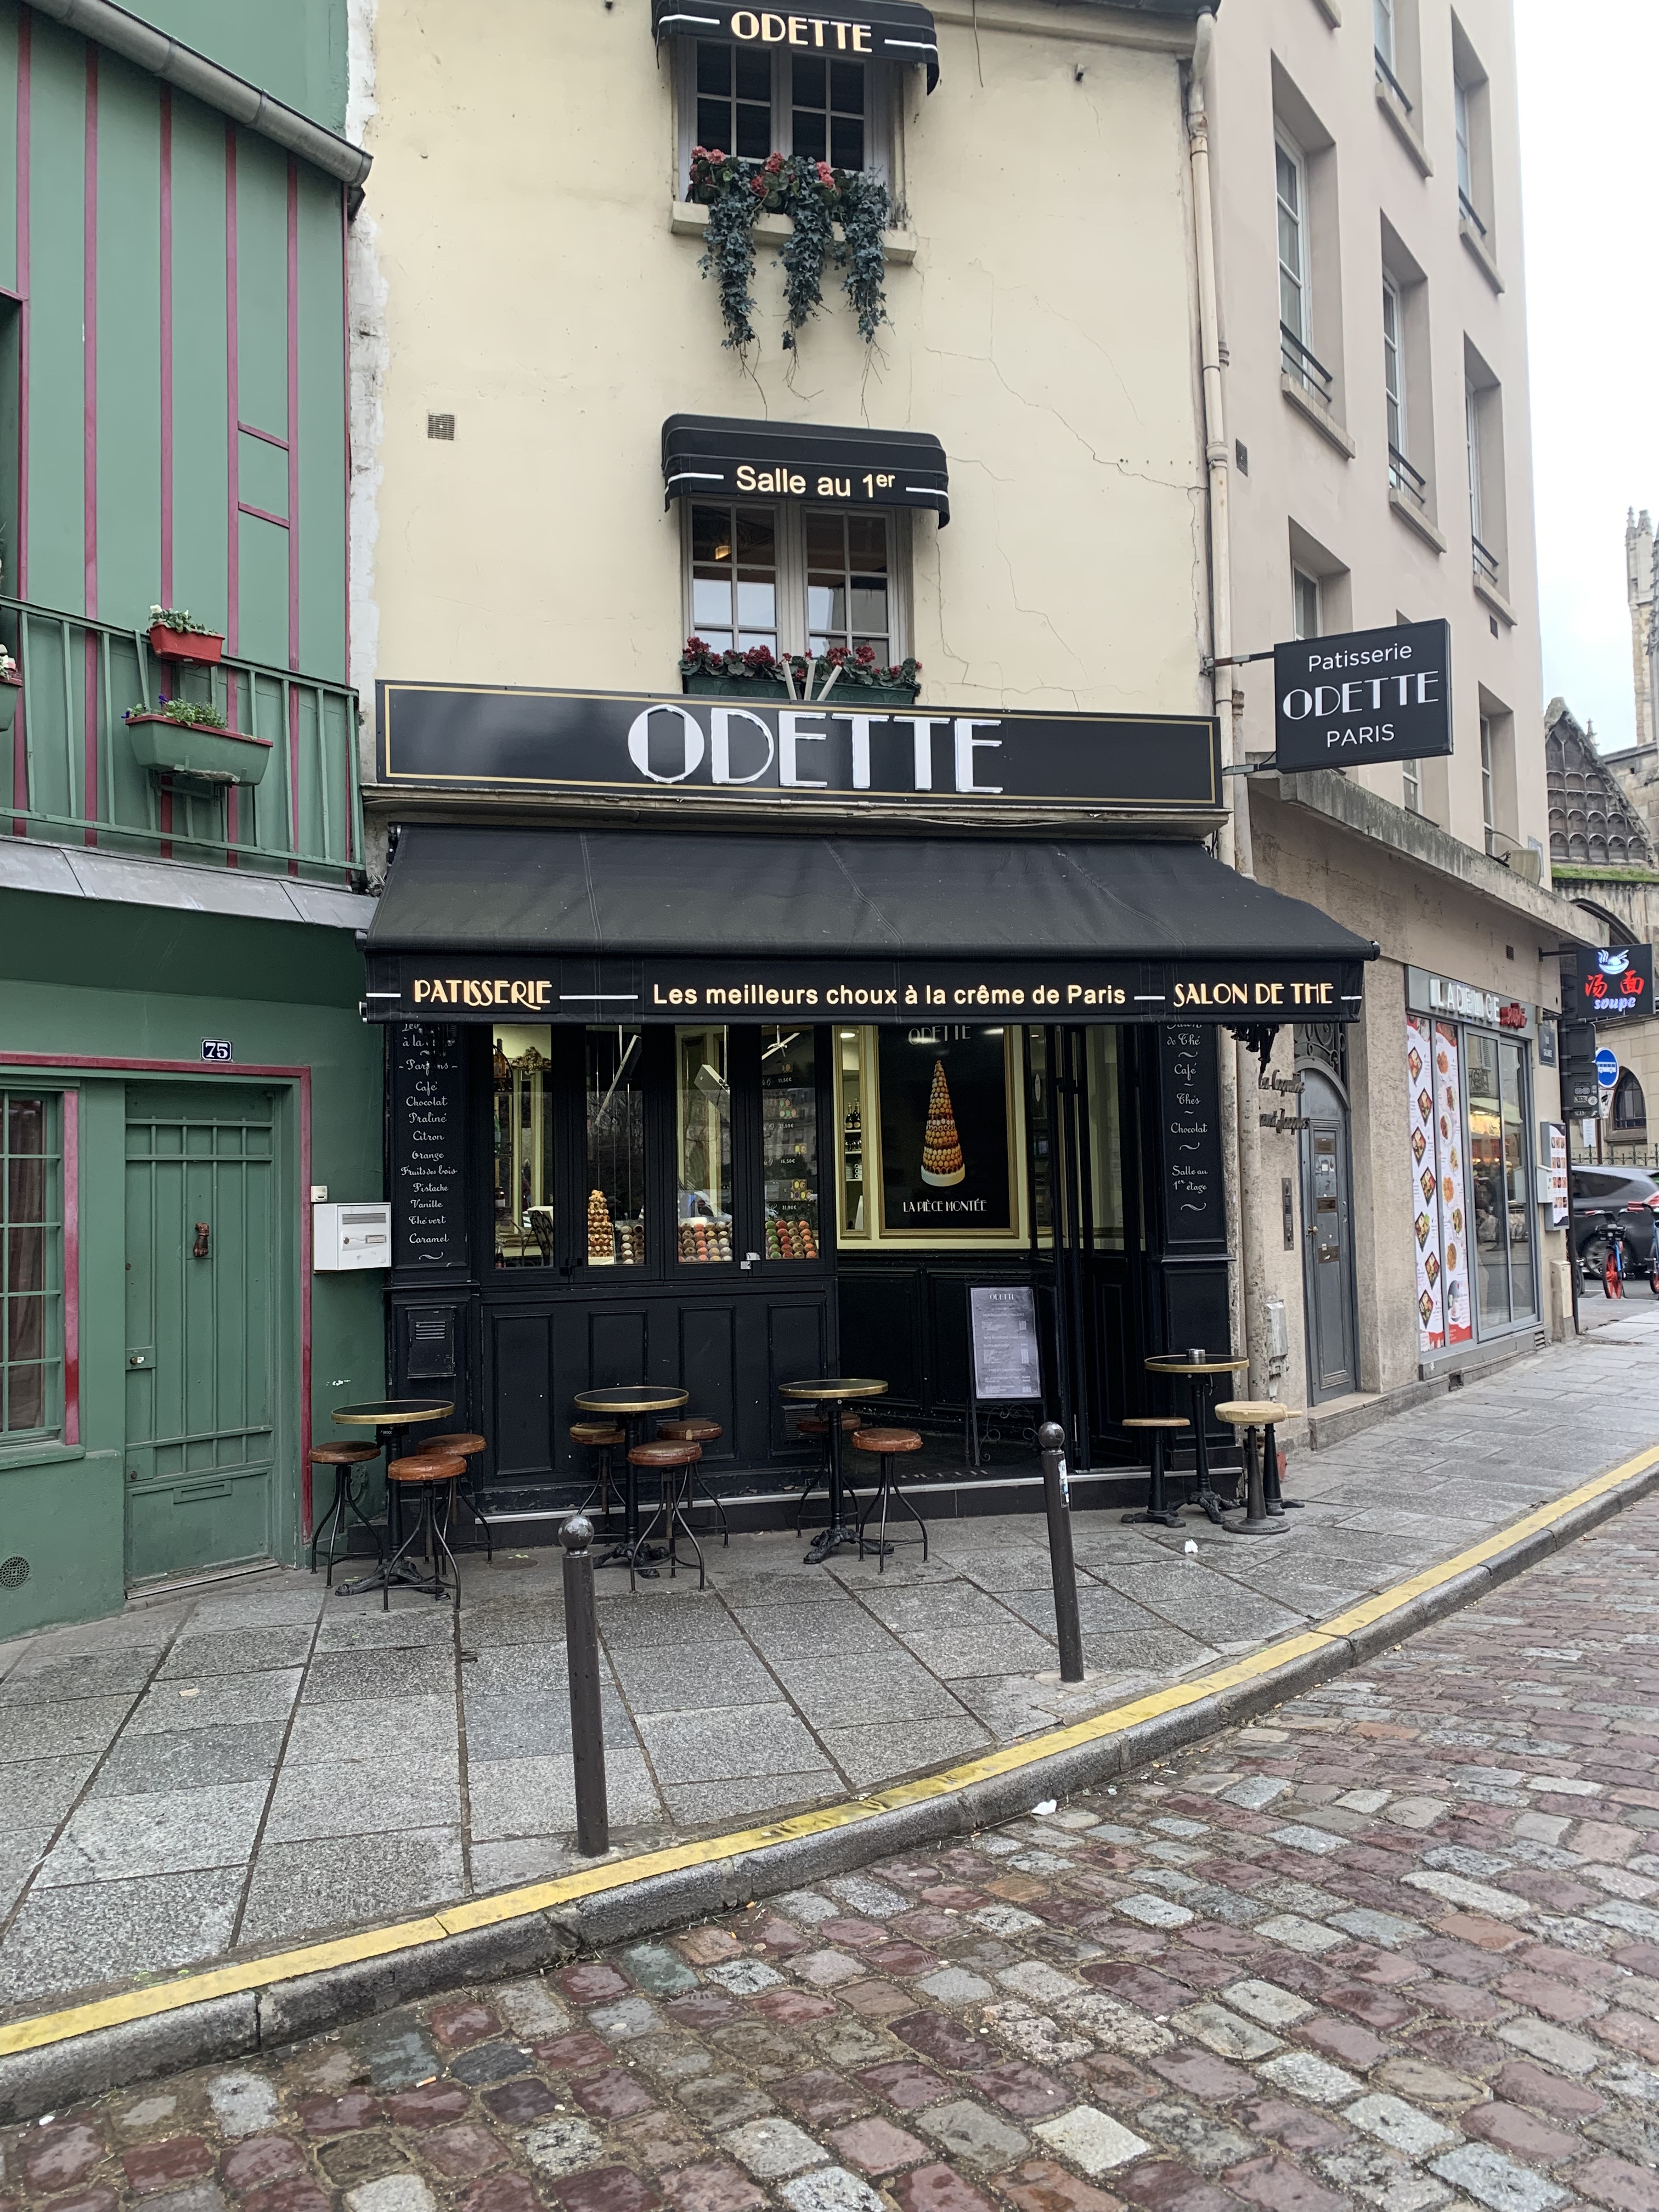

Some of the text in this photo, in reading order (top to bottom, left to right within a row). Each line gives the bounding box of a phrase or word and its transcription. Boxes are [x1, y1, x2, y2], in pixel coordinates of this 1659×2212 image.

[731, 10, 872, 53] ODETTE
[736, 465, 895, 498] Salle au 1er
[1309, 643, 1412, 672] Patisserie
[1283, 670, 1439, 720] ODETTE
[1327, 724, 1395, 748] PARIS
[628, 703, 1003, 793] ODETTE
[414, 979, 552, 1011] PATISSERIE
[653, 984, 1126, 1005] Les meilleurs choux à la crême de Paris
[1173, 983, 1334, 1008] SALON DE THE
[1594, 996, 1637, 1012] soupe
[1167, 1033, 1200, 1045] de Thé
[205, 1042, 228, 1058] 75
[1174, 1063, 1197, 1081] Café
[415, 1081, 438, 1096] Café
[406, 1096, 448, 1107] Chocolat
[1176, 1093, 1201, 1104] Thés
[409, 1112, 447, 1123] Praliné
[1171, 1122, 1208, 1133] Chocolat
[413, 1130, 444, 1141] Citron
[412, 1150, 444, 1161] Orange
[400, 1165, 426, 1176] Fruits
[438, 1165, 458, 1175] bois
[1172, 1165, 1196, 1176] Salle
[413, 1183, 449, 1193] Pistache
[410, 1199, 443, 1208] Vanille
[903, 1198, 987, 1212] LA PIÈCE MONTÉE
[408, 1215, 447, 1224] Thé vert
[409, 1233, 449, 1243] Caramel
